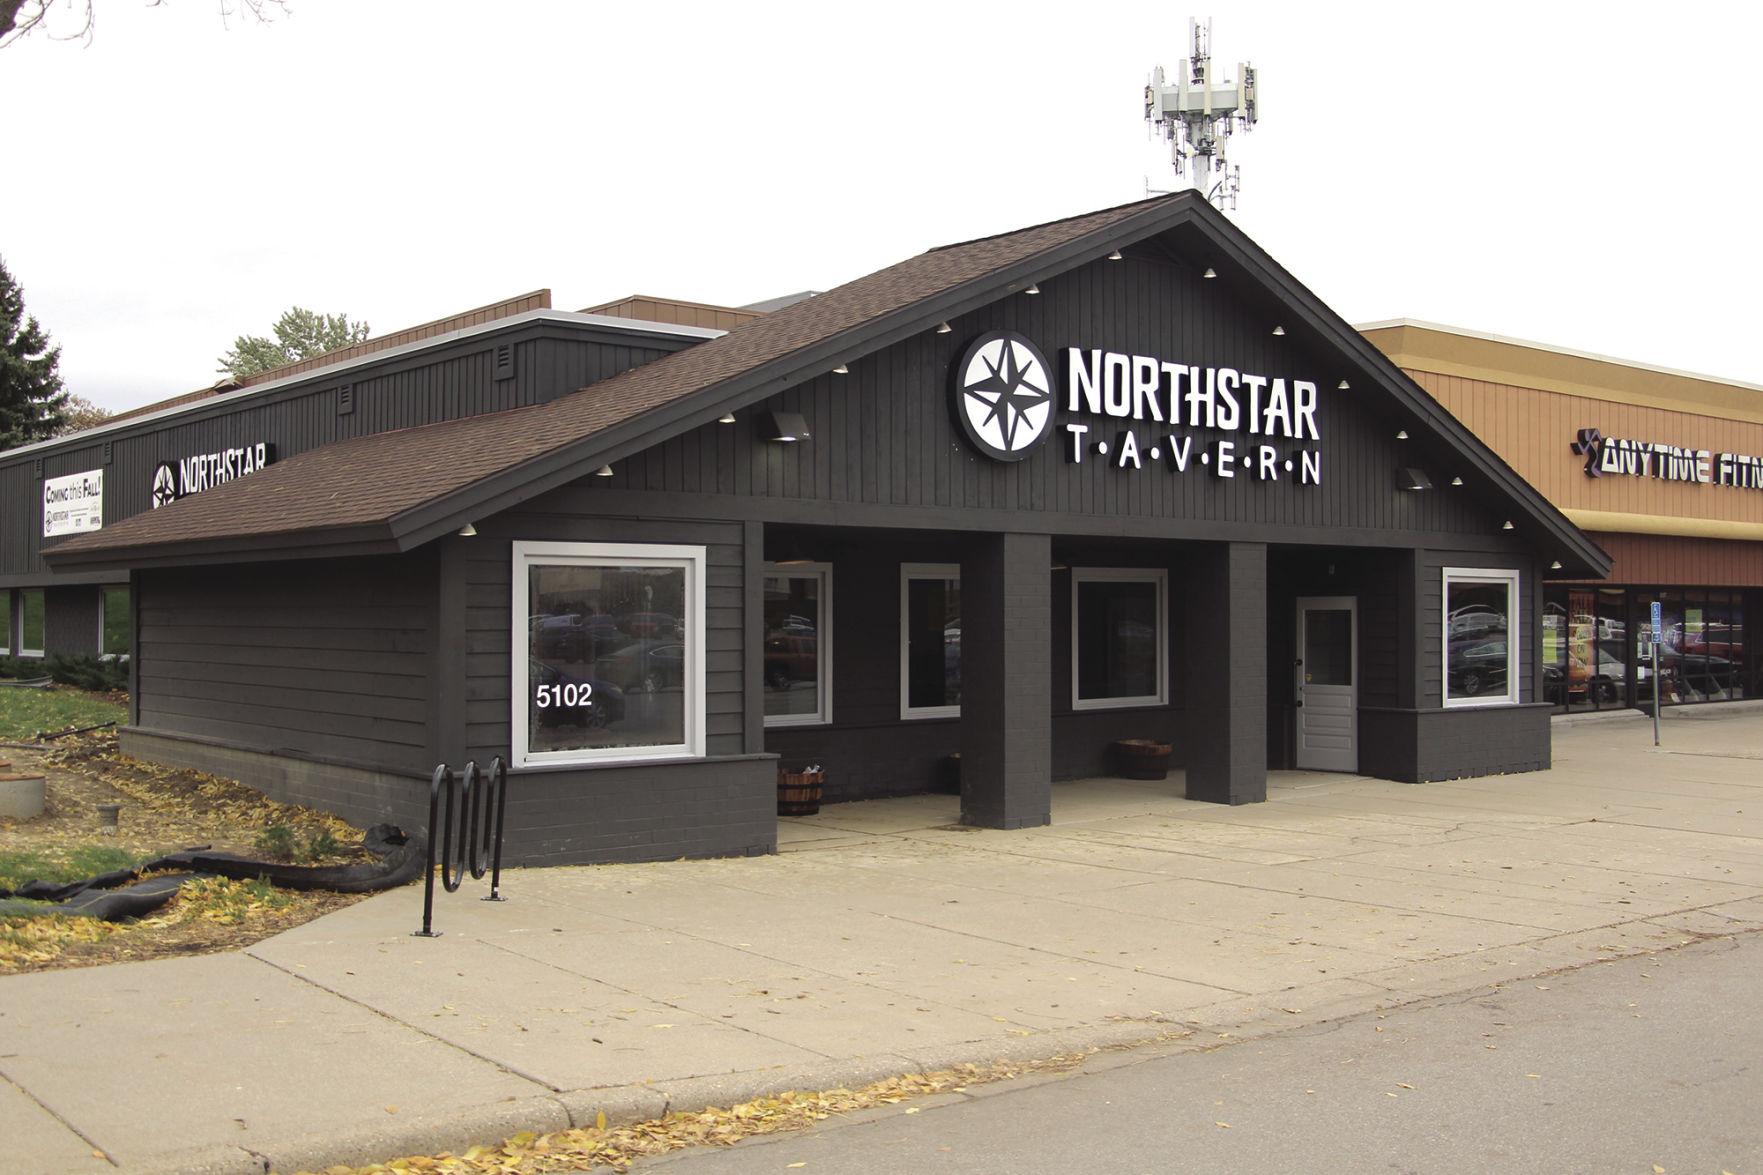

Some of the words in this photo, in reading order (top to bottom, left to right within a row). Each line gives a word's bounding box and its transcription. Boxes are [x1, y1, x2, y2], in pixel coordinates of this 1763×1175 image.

[1067, 346, 1320, 441] NORTHSTAR
[180, 443, 265, 495] NORTHSTAR
[1600, 436, 1710, 483] ANYTIME
[536, 683, 593, 708] 5102
